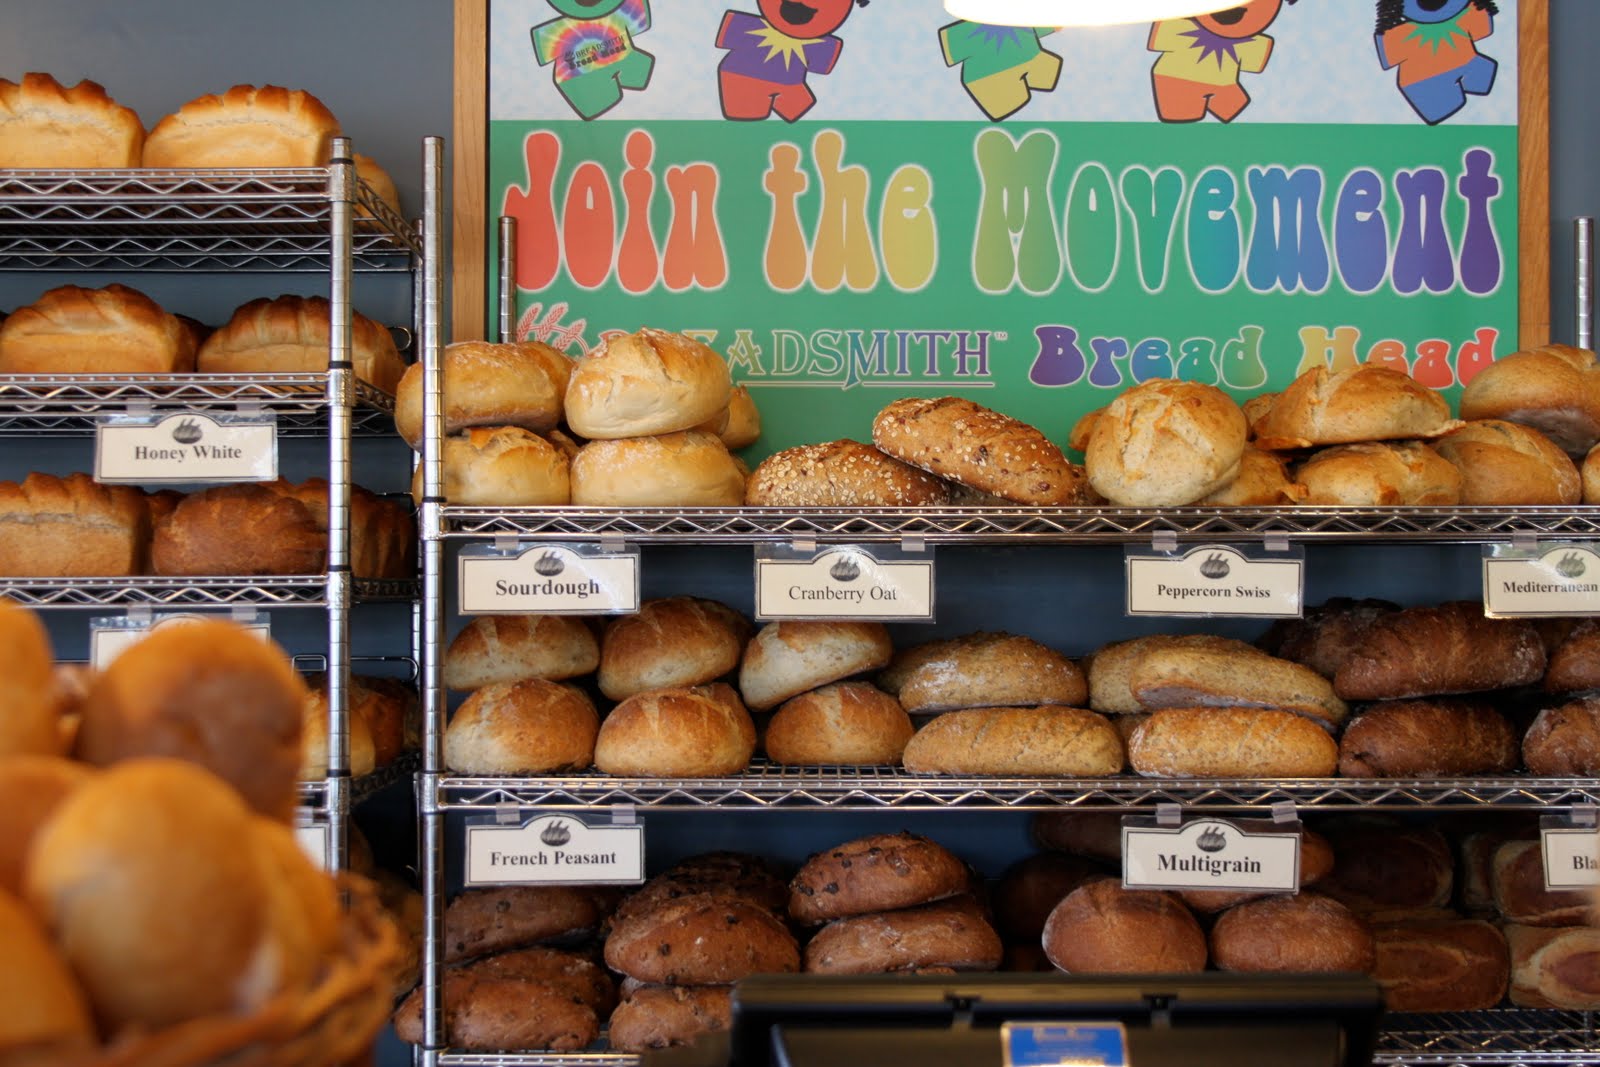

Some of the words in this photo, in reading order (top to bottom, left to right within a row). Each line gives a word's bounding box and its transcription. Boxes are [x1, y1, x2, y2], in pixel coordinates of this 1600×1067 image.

[504, 130, 727, 293] Join
[763, 129, 938, 293] the
[972, 128, 1502, 294] Movement
[1028, 324, 1268, 389] Bread
[1297, 325, 1498, 390] Head
[134, 446, 187, 462] Honey
[193, 445, 242, 459] White
[495, 579, 600, 598] Sourdough
[789, 586, 865, 603] Cranberry
[870, 586, 897, 600] Oat
[1157, 584, 1231, 600] Peppercorn
[1235, 586, 1271, 598] Swiss
[1503, 582, 1598, 593] Mediterranean
[490, 851, 548, 866] French
[554, 851, 616, 865] Peasant
[1157, 854, 1261, 877] Multigrain
